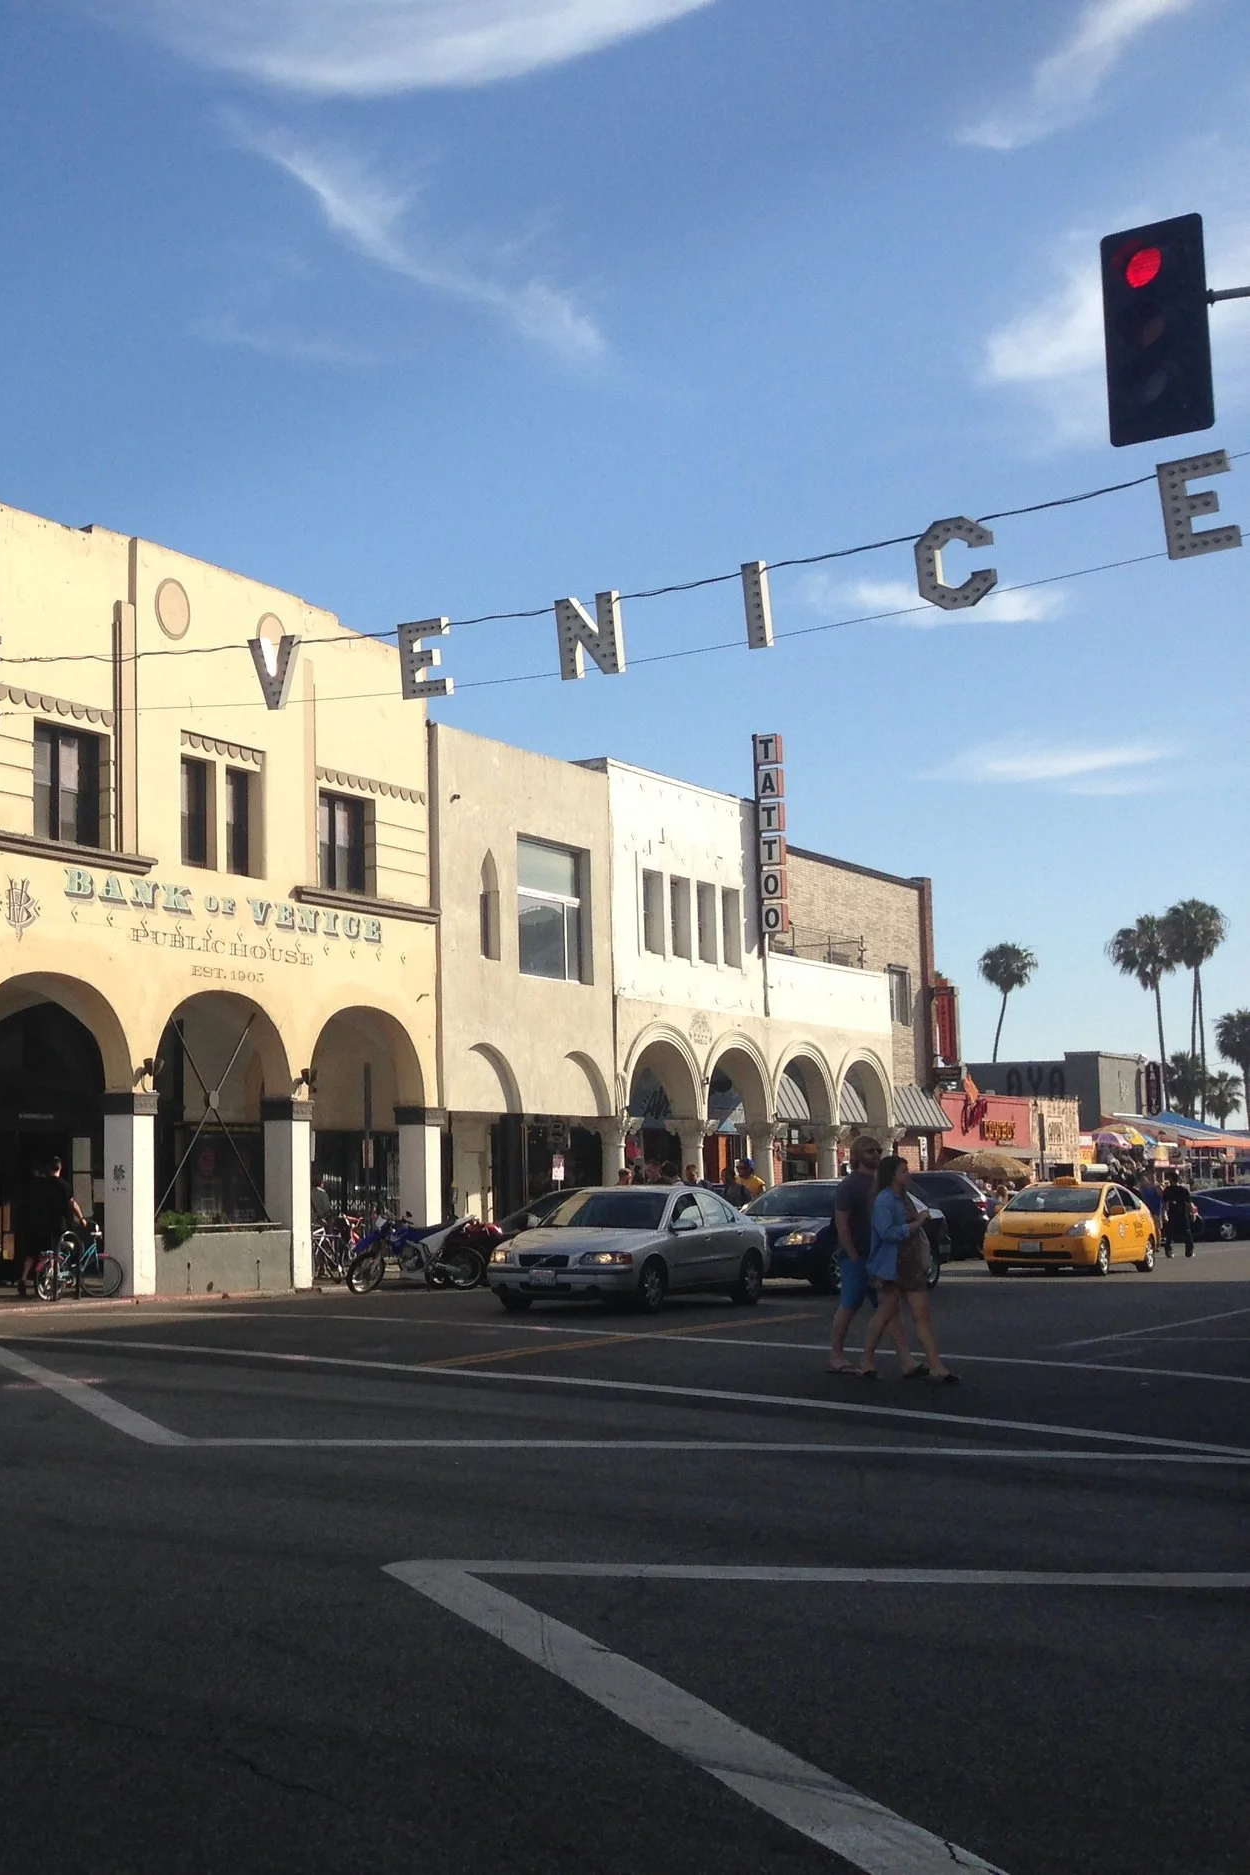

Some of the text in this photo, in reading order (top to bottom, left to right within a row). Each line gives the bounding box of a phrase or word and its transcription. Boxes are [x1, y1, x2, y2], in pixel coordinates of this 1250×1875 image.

[247, 449, 1241, 710] VENICE
[758, 738, 780, 929] TATTOO
[64, 867, 382, 943] BANK OF VENICE
[130, 928, 314, 966] PUBLIC HOUSE
[191, 965, 265, 983] EST. 1905
